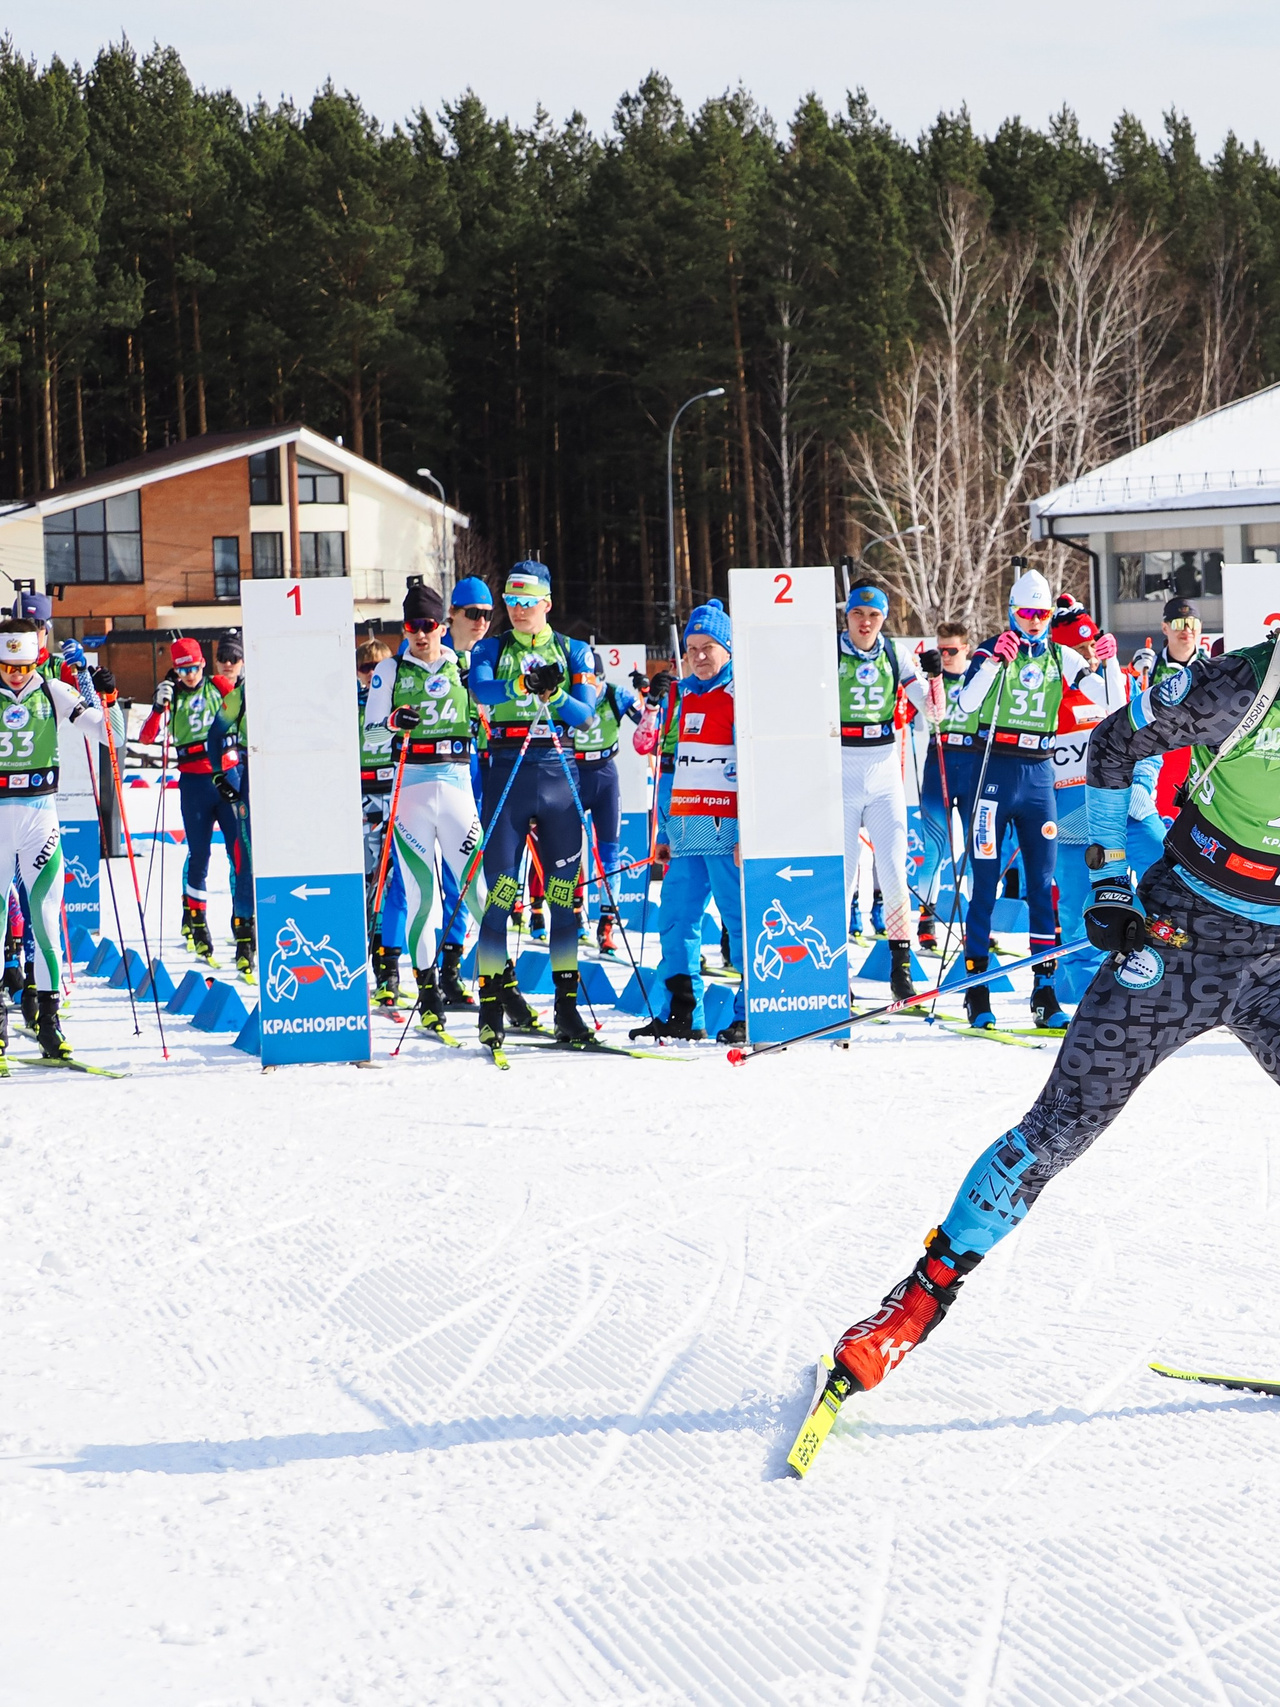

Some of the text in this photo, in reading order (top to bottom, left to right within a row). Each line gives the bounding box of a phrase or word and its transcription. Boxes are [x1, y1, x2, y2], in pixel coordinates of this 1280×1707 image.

[286, 584, 302, 616] 1
[773, 573, 794, 604] 2
[609, 648, 620, 666] 3
[1199, 637, 1210, 652] 5
[850, 686, 885, 711] 35
[1009, 689, 1047, 718] 31
[420, 698, 458, 726] 34
[1241, 694, 1270, 732] LARSEN
[0, 731, 34, 758] 33
[702, 796, 730, 806] край
[1098, 891, 1132, 903] KV+
[749, 994, 848, 1013] КРАСНОЯРСК
[262, 1015, 368, 1035] КРАСНОЯРСК
